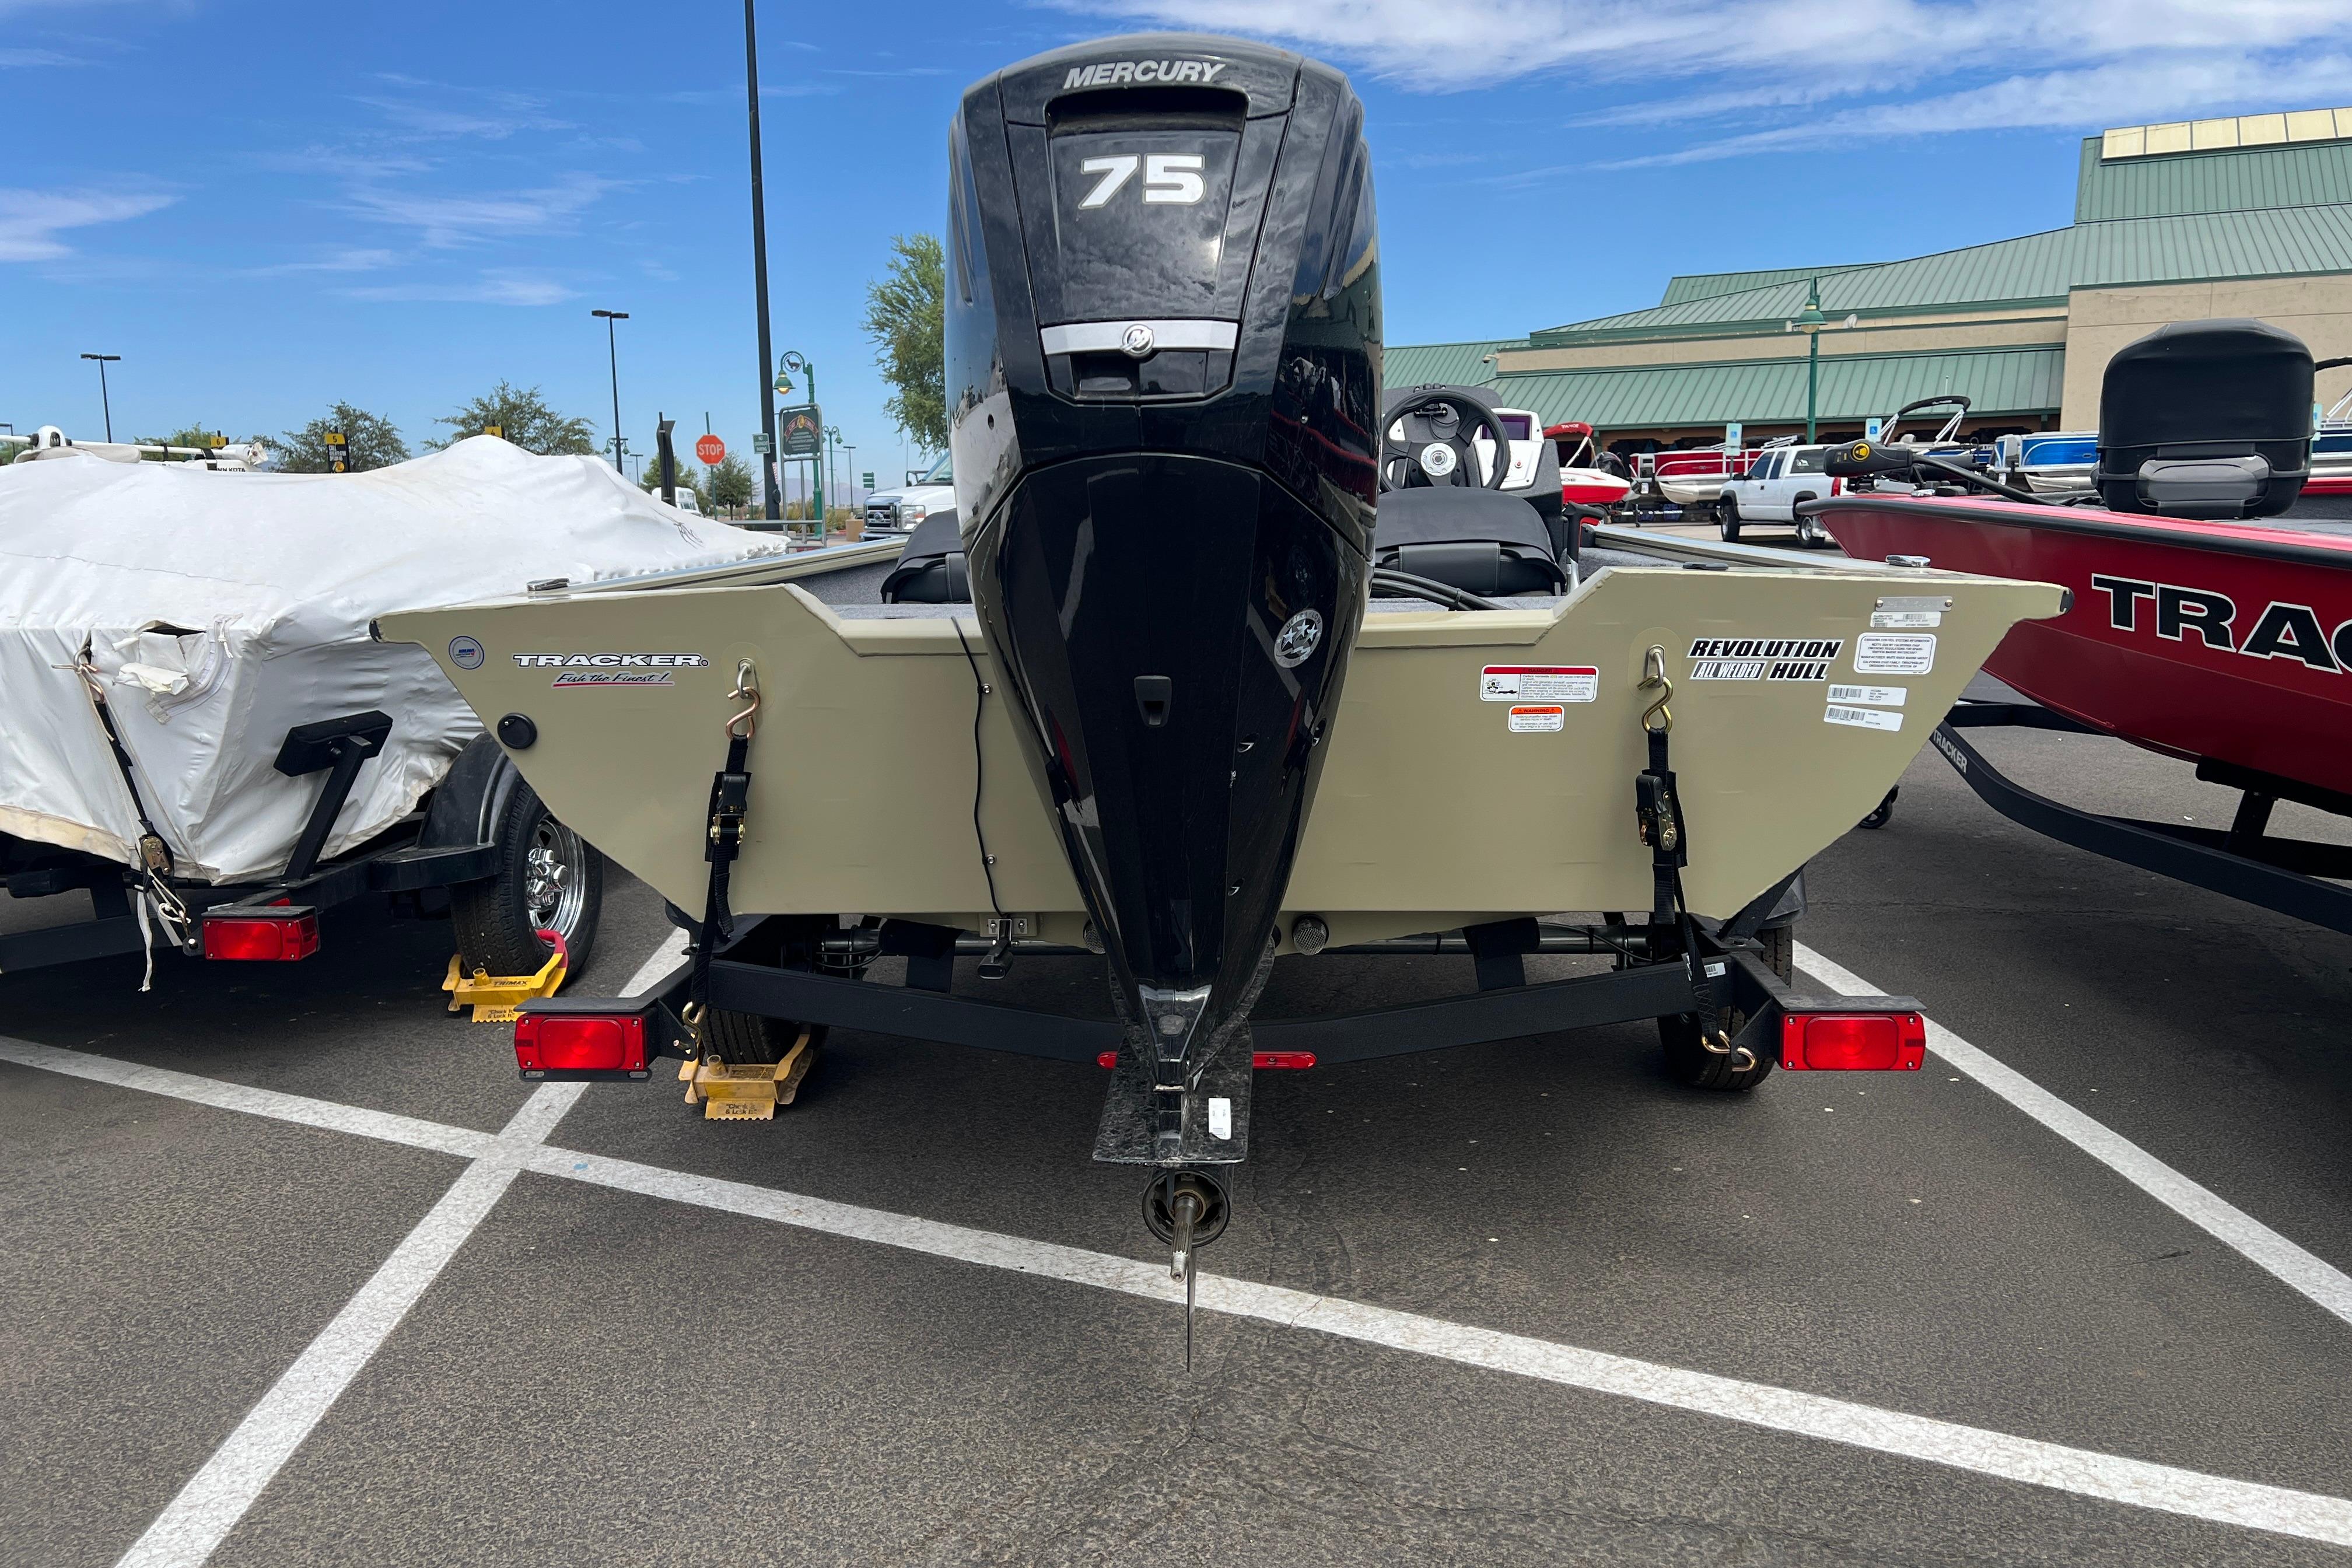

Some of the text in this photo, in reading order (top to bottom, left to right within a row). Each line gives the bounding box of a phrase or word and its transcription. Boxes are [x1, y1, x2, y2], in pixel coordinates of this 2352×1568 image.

[1063, 60, 1226, 90] MERCURY
[1078, 153, 1207, 209] 75
[698, 444, 723, 455] STOP
[2091, 573, 2352, 674] TRA
[1689, 640, 1842, 658] REVOLUTION
[556, 673, 588, 682] Fish
[589, 673, 611, 682] the
[612, 673, 654, 682] Finest
[1696, 663, 1829, 680] ALL WELDED HULL
[1933, 729, 1968, 775] TRACKER
